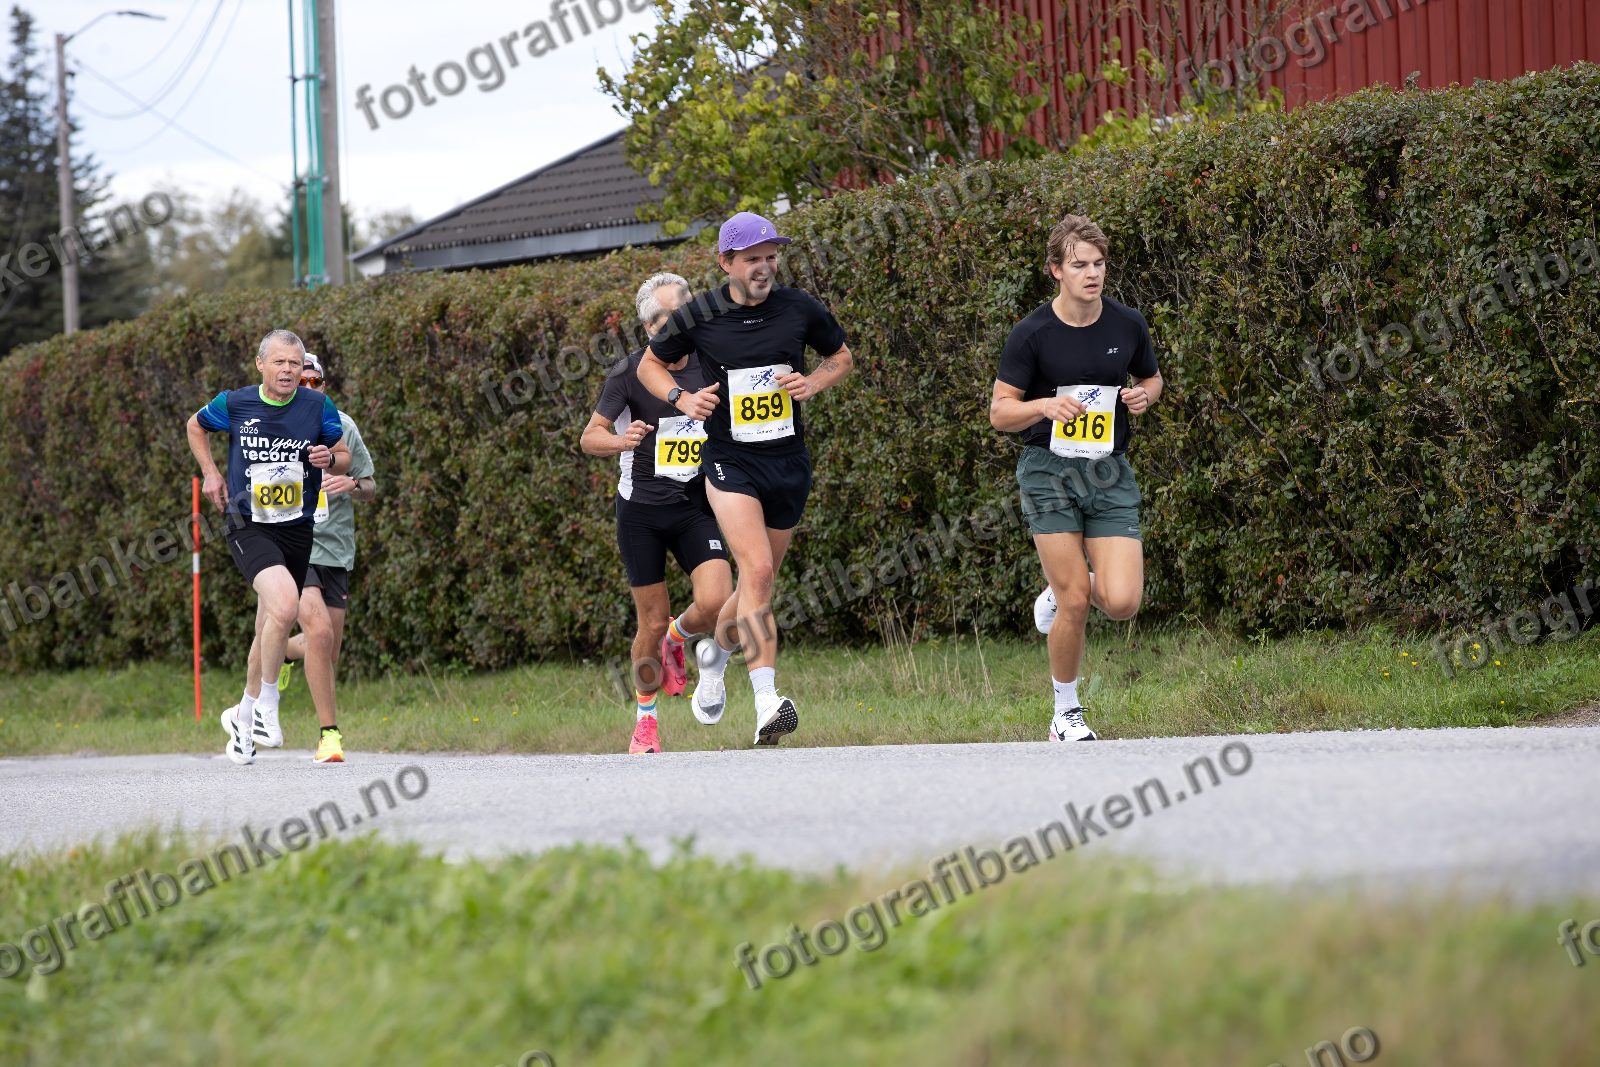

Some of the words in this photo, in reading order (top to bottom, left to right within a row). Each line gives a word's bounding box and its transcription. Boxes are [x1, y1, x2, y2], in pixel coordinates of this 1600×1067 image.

[741, 393, 784, 421] 859
[239, 426, 259, 434] 2026
[1063, 413, 1106, 440] 816
[240, 436, 270, 449] run
[269, 438, 311, 454] your
[243, 449, 300, 463] record
[664, 440, 702, 464] 799
[260, 484, 295, 506] 820
